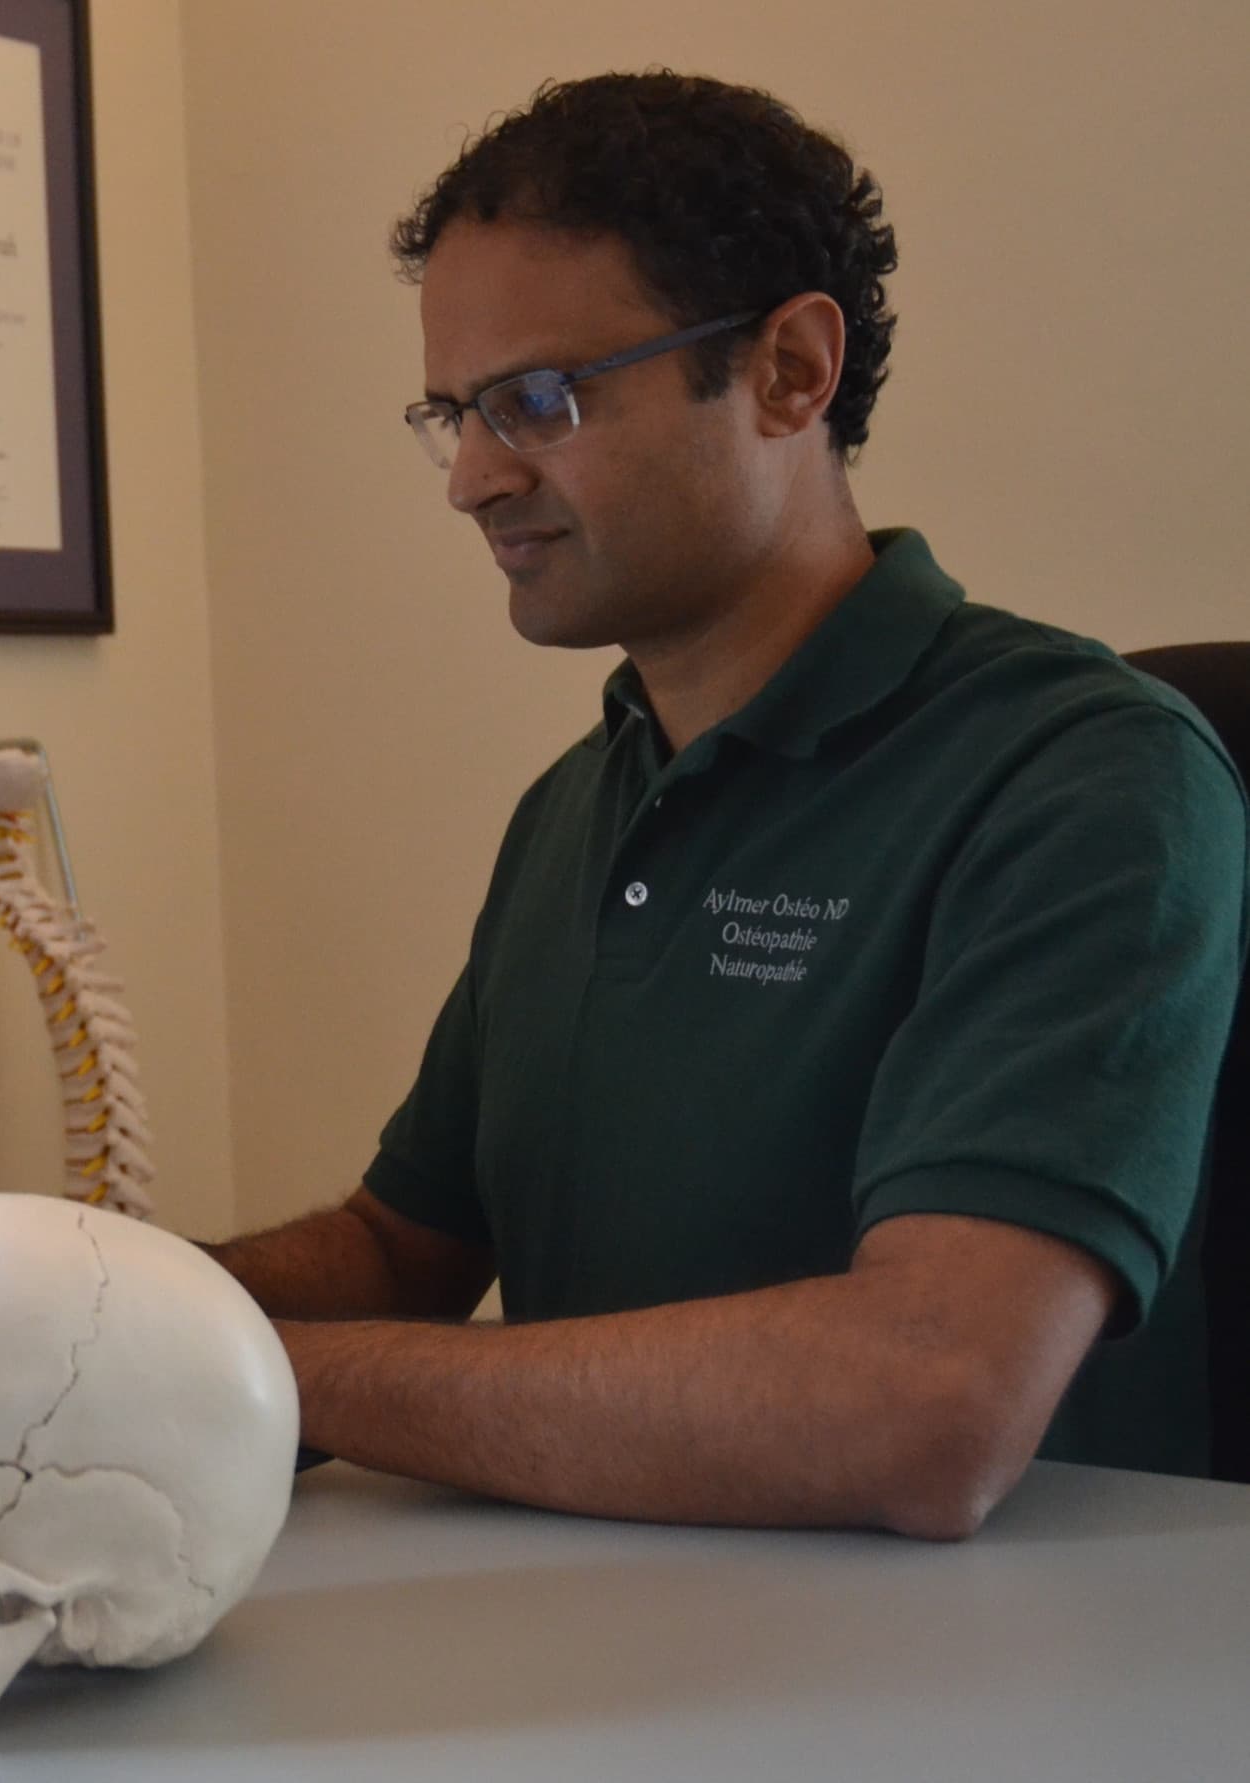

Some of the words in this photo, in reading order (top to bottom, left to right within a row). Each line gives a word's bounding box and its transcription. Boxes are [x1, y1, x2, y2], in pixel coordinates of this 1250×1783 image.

[703, 887, 771, 915] Aylmer
[772, 893, 821, 920] Ostéo
[823, 897, 851, 921] ND
[721, 921, 819, 955] Ostéopathie
[709, 953, 808, 986] Naturopathie
